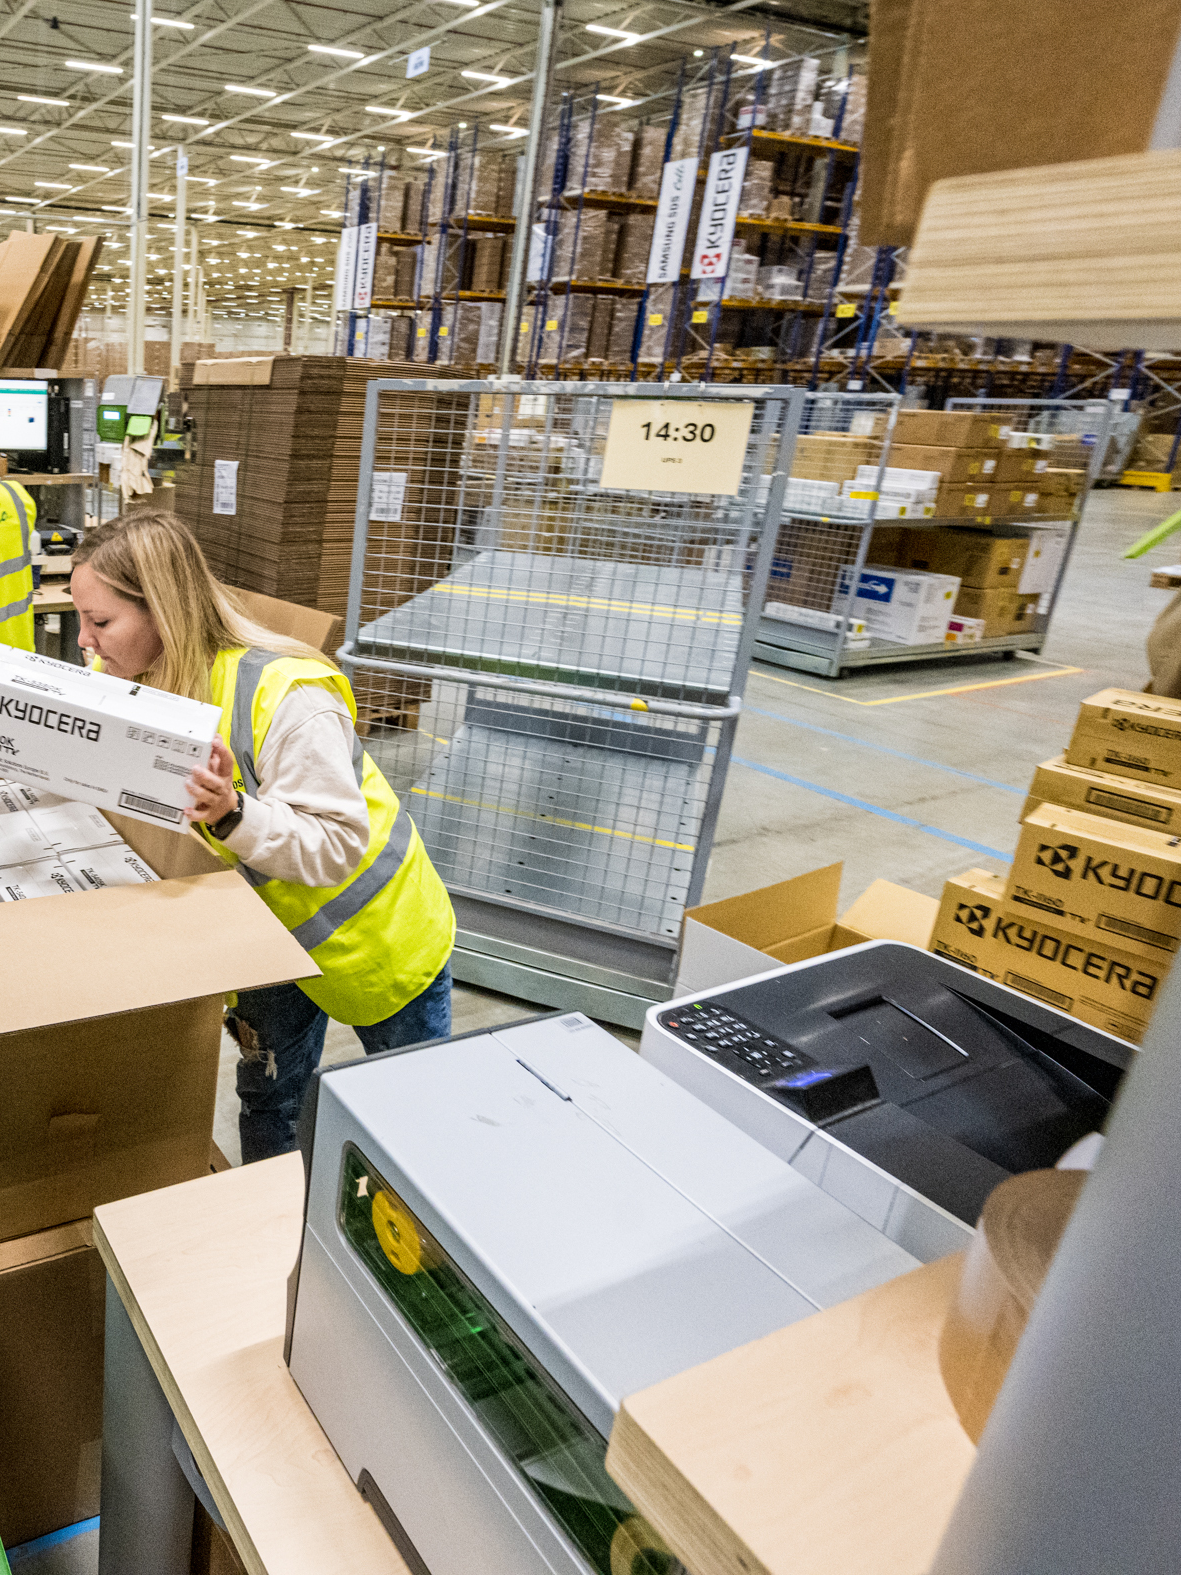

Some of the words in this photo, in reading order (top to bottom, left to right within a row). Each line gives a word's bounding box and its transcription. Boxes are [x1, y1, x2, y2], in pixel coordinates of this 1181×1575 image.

[706, 152, 737, 249] KYOCERA
[360, 226, 371, 288] KYOCERA
[658, 221, 676, 279] SAMSUNG
[668, 196, 680, 218] SDS
[641, 421, 716, 442] 14:30
[39, 658, 91, 677] KYOCERA
[0, 696, 101, 742] KYOCERA
[993, 916, 1159, 1000] KYOCERA
